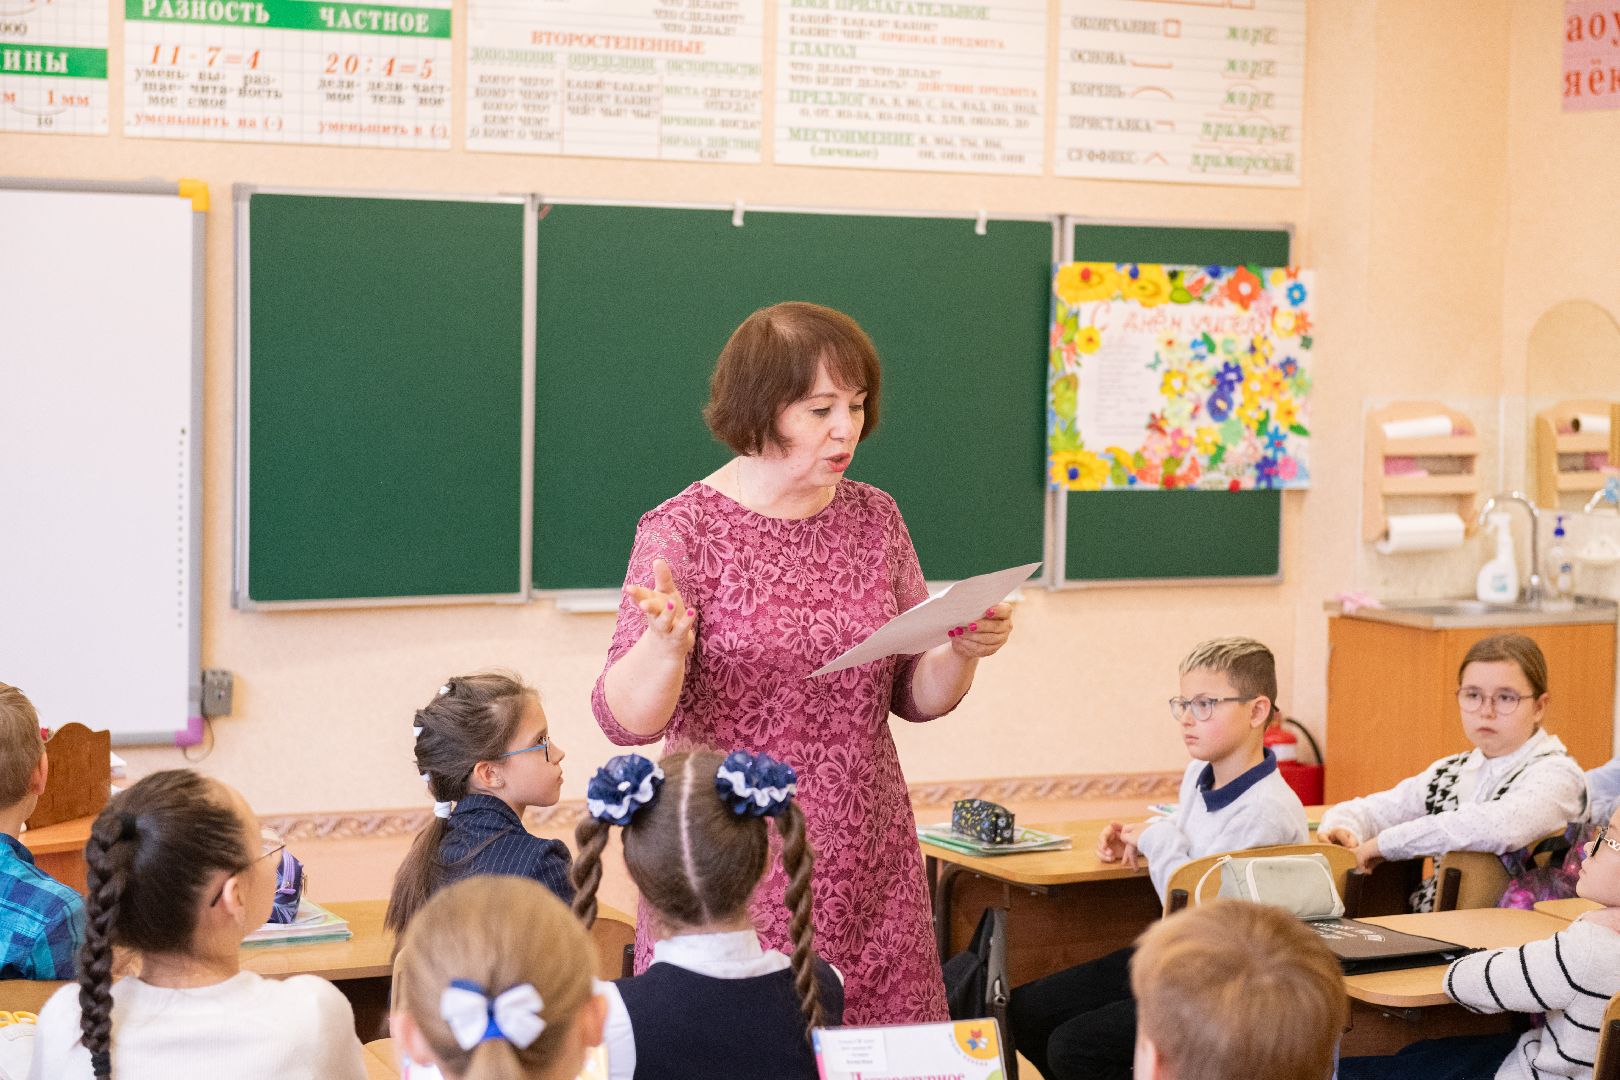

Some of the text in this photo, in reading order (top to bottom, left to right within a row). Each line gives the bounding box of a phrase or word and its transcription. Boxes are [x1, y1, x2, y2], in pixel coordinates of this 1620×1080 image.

[142, 0, 430, 33] РАЗНОСТЬ ЧАСТНОЕ
[531, 30, 705, 54] ВТОРОСТЕПЕННЫЕ
[789, 41, 857, 58] ГЛАГОЛ
